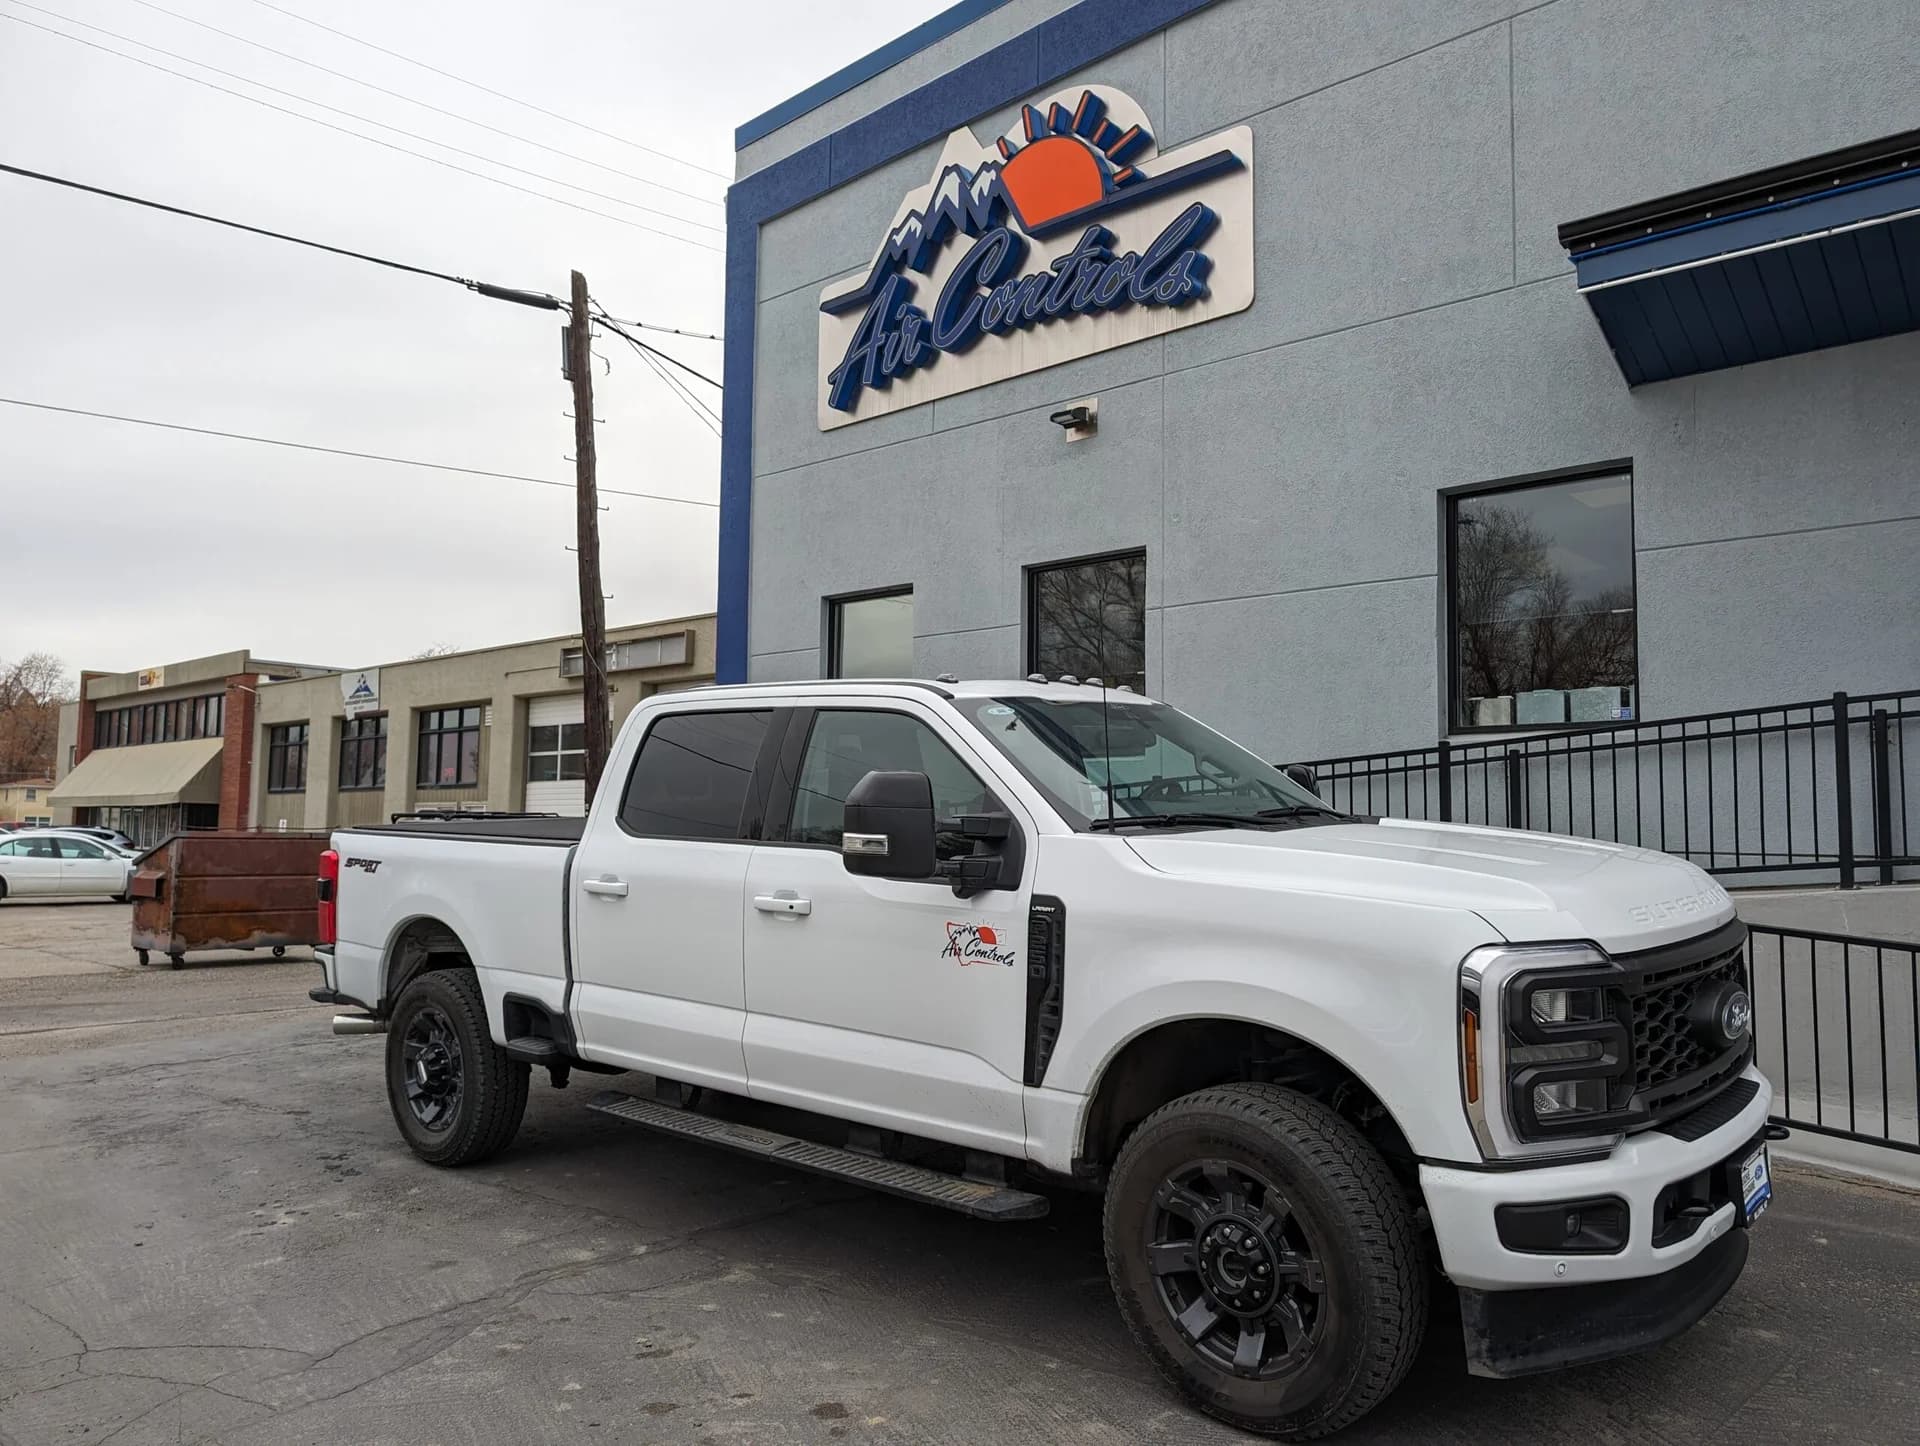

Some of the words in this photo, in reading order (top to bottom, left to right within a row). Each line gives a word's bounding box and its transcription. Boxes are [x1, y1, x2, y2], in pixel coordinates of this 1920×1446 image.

[828, 274, 932, 411] Air
[931, 202, 1212, 354] Controls
[344, 858, 382, 868] SPORT
[941, 936, 962, 958] Air
[964, 937, 1015, 966] Controls
